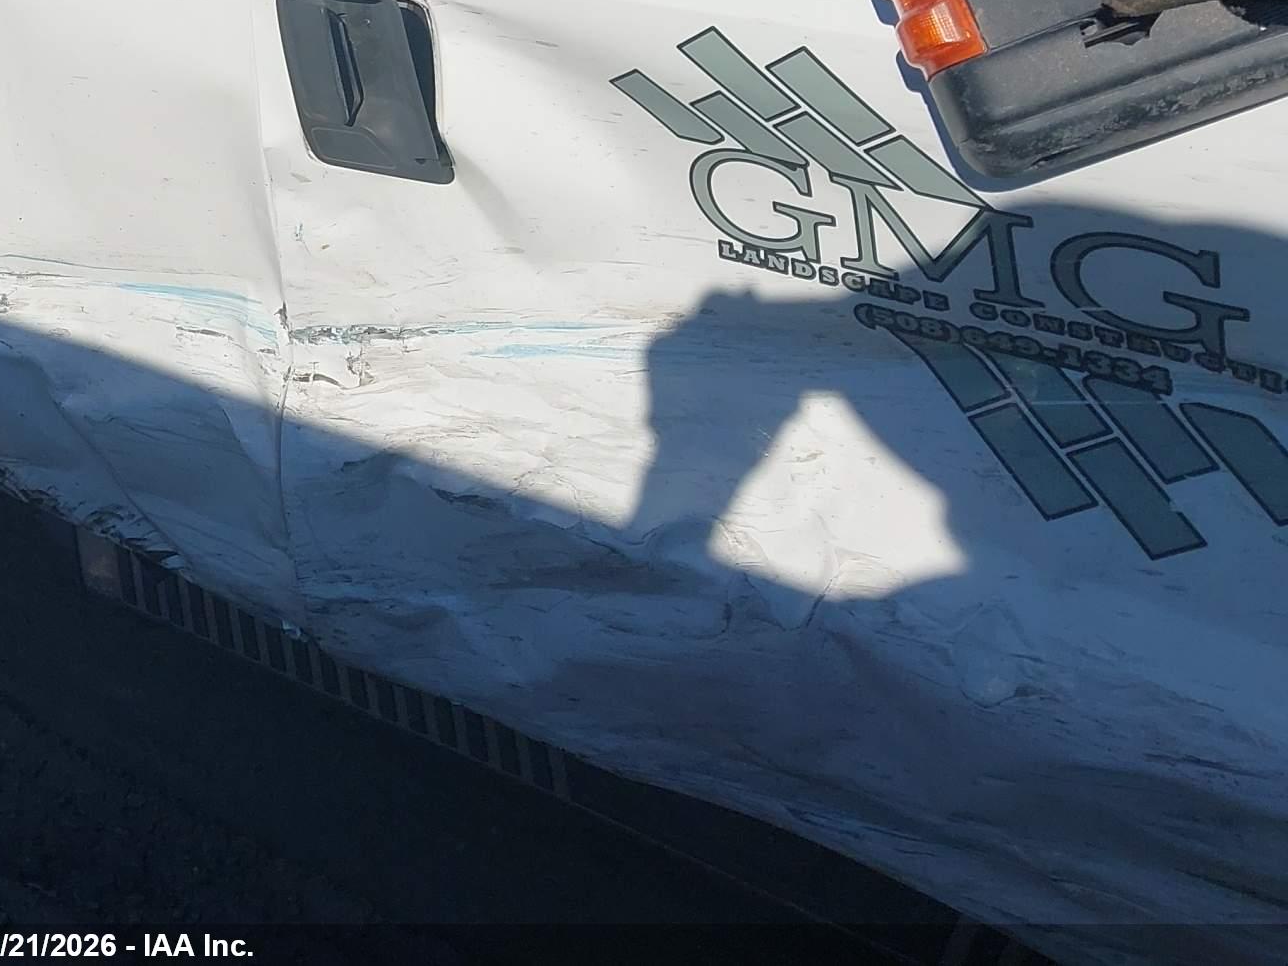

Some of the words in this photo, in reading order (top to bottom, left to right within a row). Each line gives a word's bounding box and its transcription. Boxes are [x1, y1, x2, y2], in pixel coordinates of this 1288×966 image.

[688, 147, 1251, 357] GMG
[718, 239, 951, 311] LANDSCAPE
[968, 301, 1288, 395] CONSTRUCTI
